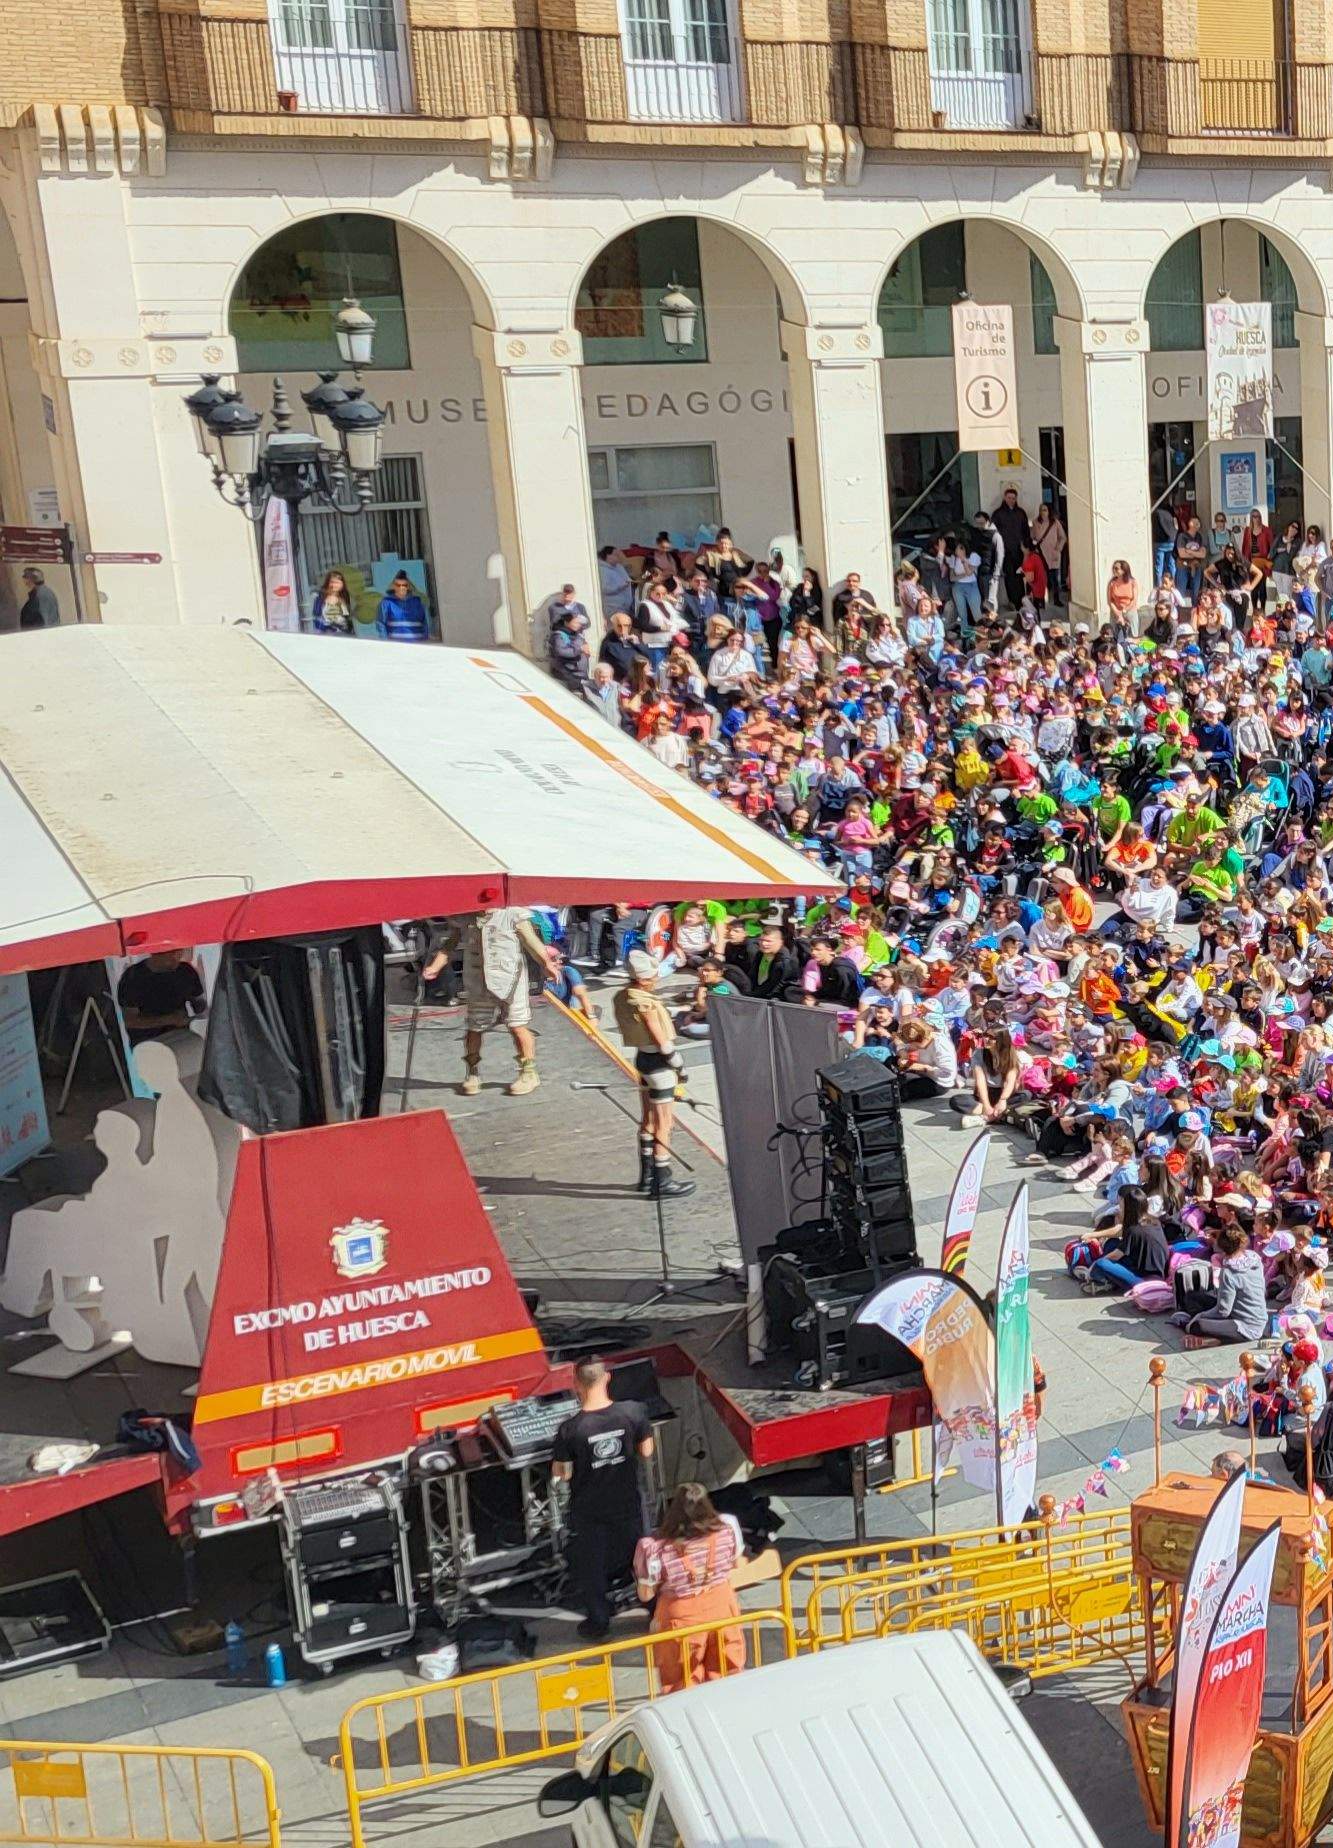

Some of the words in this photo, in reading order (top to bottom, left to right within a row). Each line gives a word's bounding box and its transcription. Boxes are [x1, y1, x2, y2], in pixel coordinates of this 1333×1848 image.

[965, 320, 1005, 331] Oficina
[991, 334, 1006, 344] de
[962, 346, 1006, 357] Turismo
[234, 1301, 317, 1335] EXCMO
[319, 1267, 492, 1318] AYUNTAMIENTO
[304, 1328, 336, 1352] DE
[338, 1310, 431, 1345] HUESCA
[261, 1359, 407, 1406] ESCENARIO
[408, 1343, 482, 1373] MOVIL
[1216, 1601, 1265, 1634] MARCHA
[1209, 1659, 1233, 1684] PIO
[1234, 1648, 1253, 1672] XII
